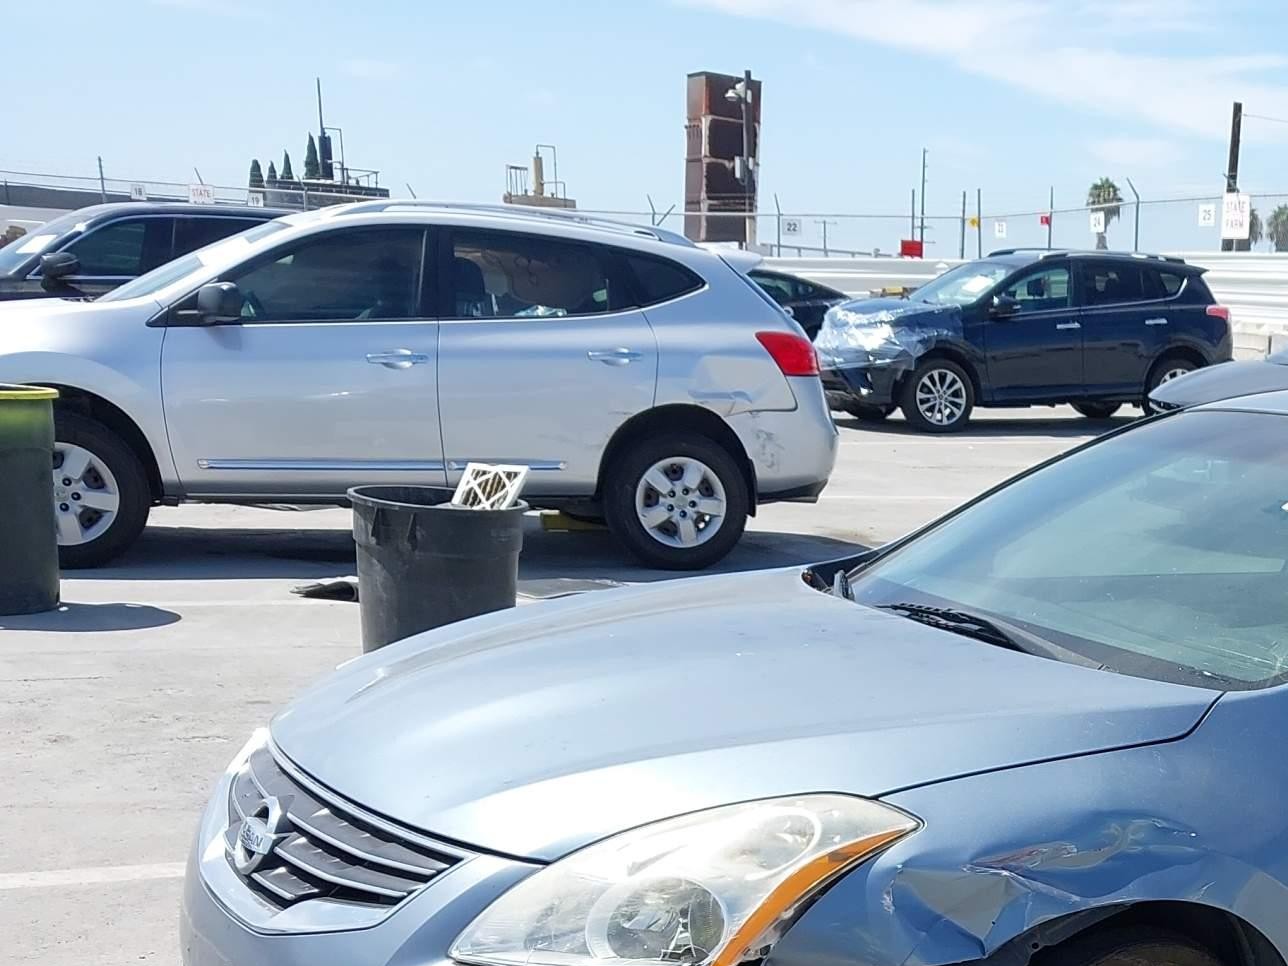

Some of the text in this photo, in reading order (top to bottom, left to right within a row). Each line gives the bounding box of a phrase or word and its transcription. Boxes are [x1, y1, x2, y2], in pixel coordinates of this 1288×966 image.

[191, 188, 211, 198] STATE
[1202, 209, 1212, 222] 25
[786, 222, 798, 232] 22
